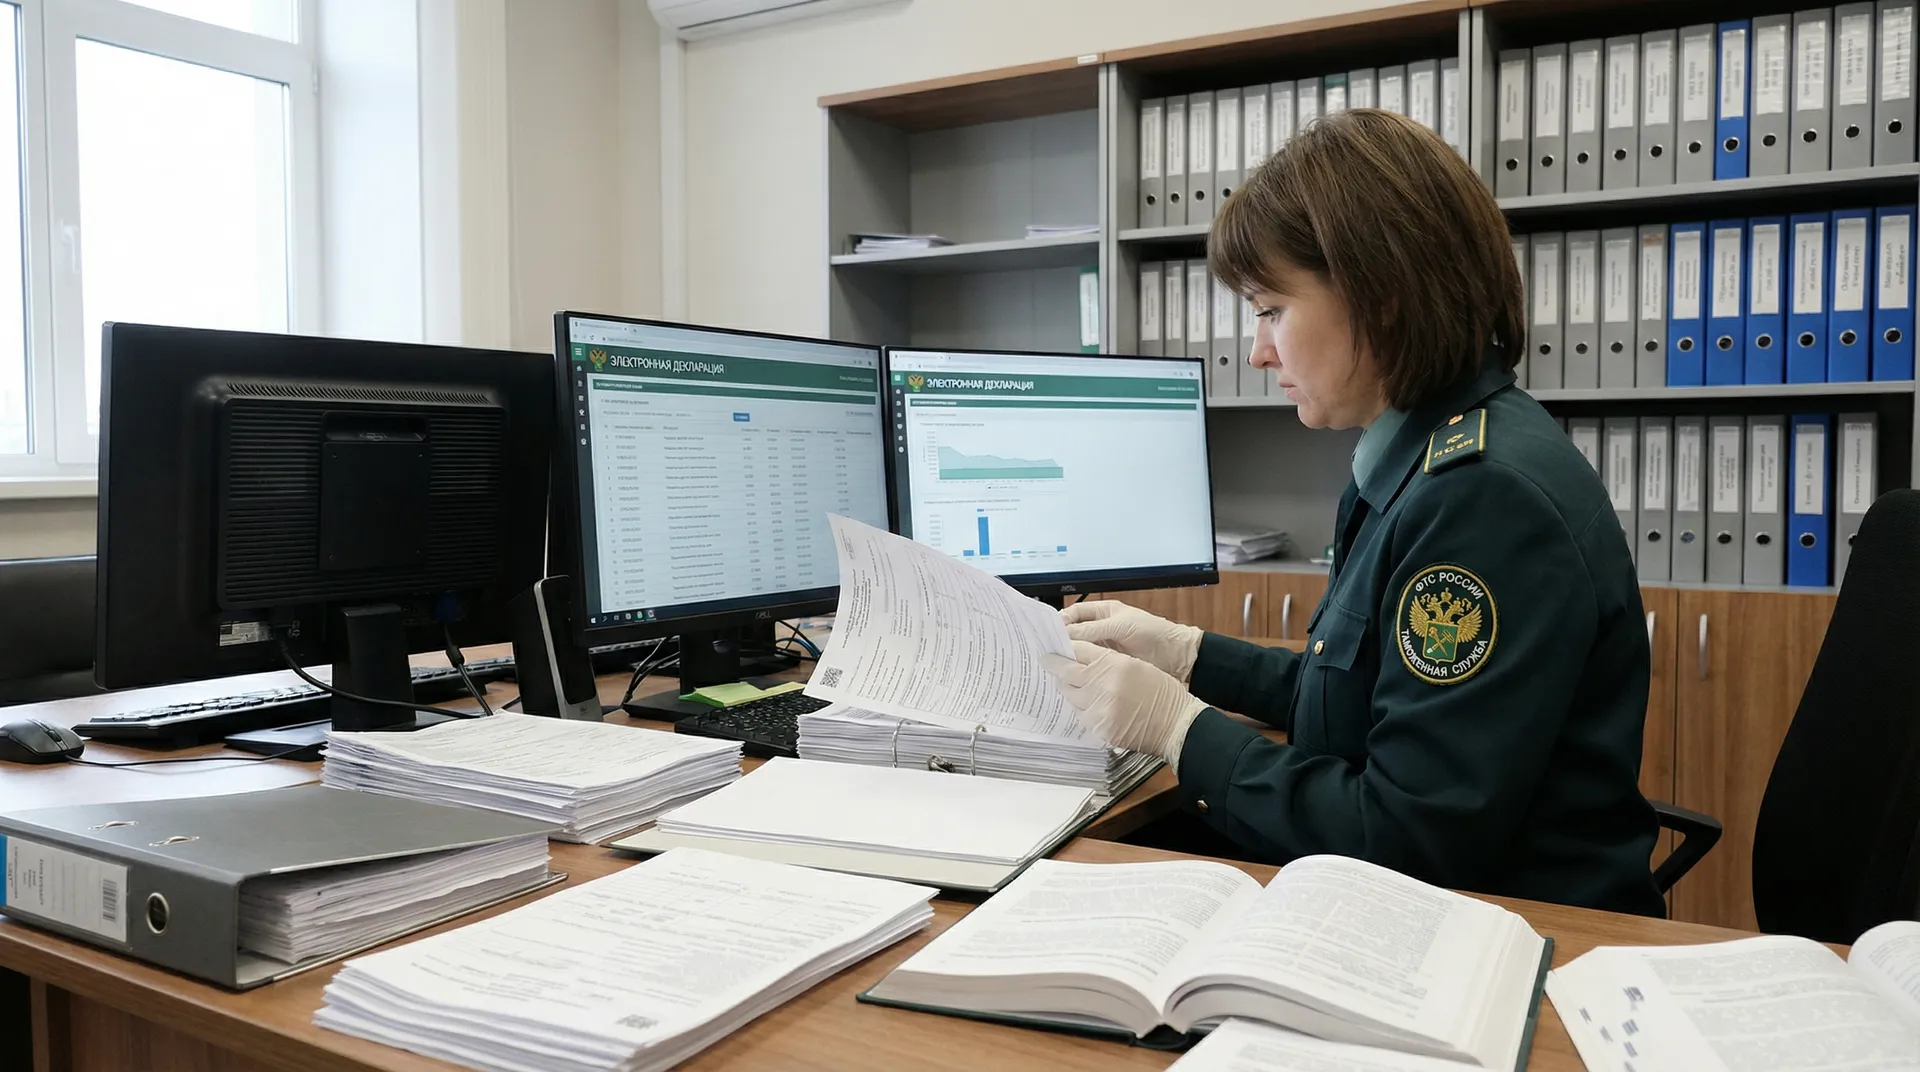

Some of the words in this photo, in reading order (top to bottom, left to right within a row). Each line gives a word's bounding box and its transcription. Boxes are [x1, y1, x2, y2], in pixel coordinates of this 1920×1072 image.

[610, 355, 672, 371] ЭЛЕКТРОННАЯ
[673, 360, 724, 375] ДЕКЛАРАЦИЯ
[927, 378, 983, 389] ЭЛЕКТРОННАЯ
[1415, 574, 1436, 591] ФТС
[1439, 572, 1484, 600] РОССИИ
[1401, 629, 1447, 676] ТАМОЖЕННАЯ
[1452, 640, 1488, 674] СЛУЖБА
